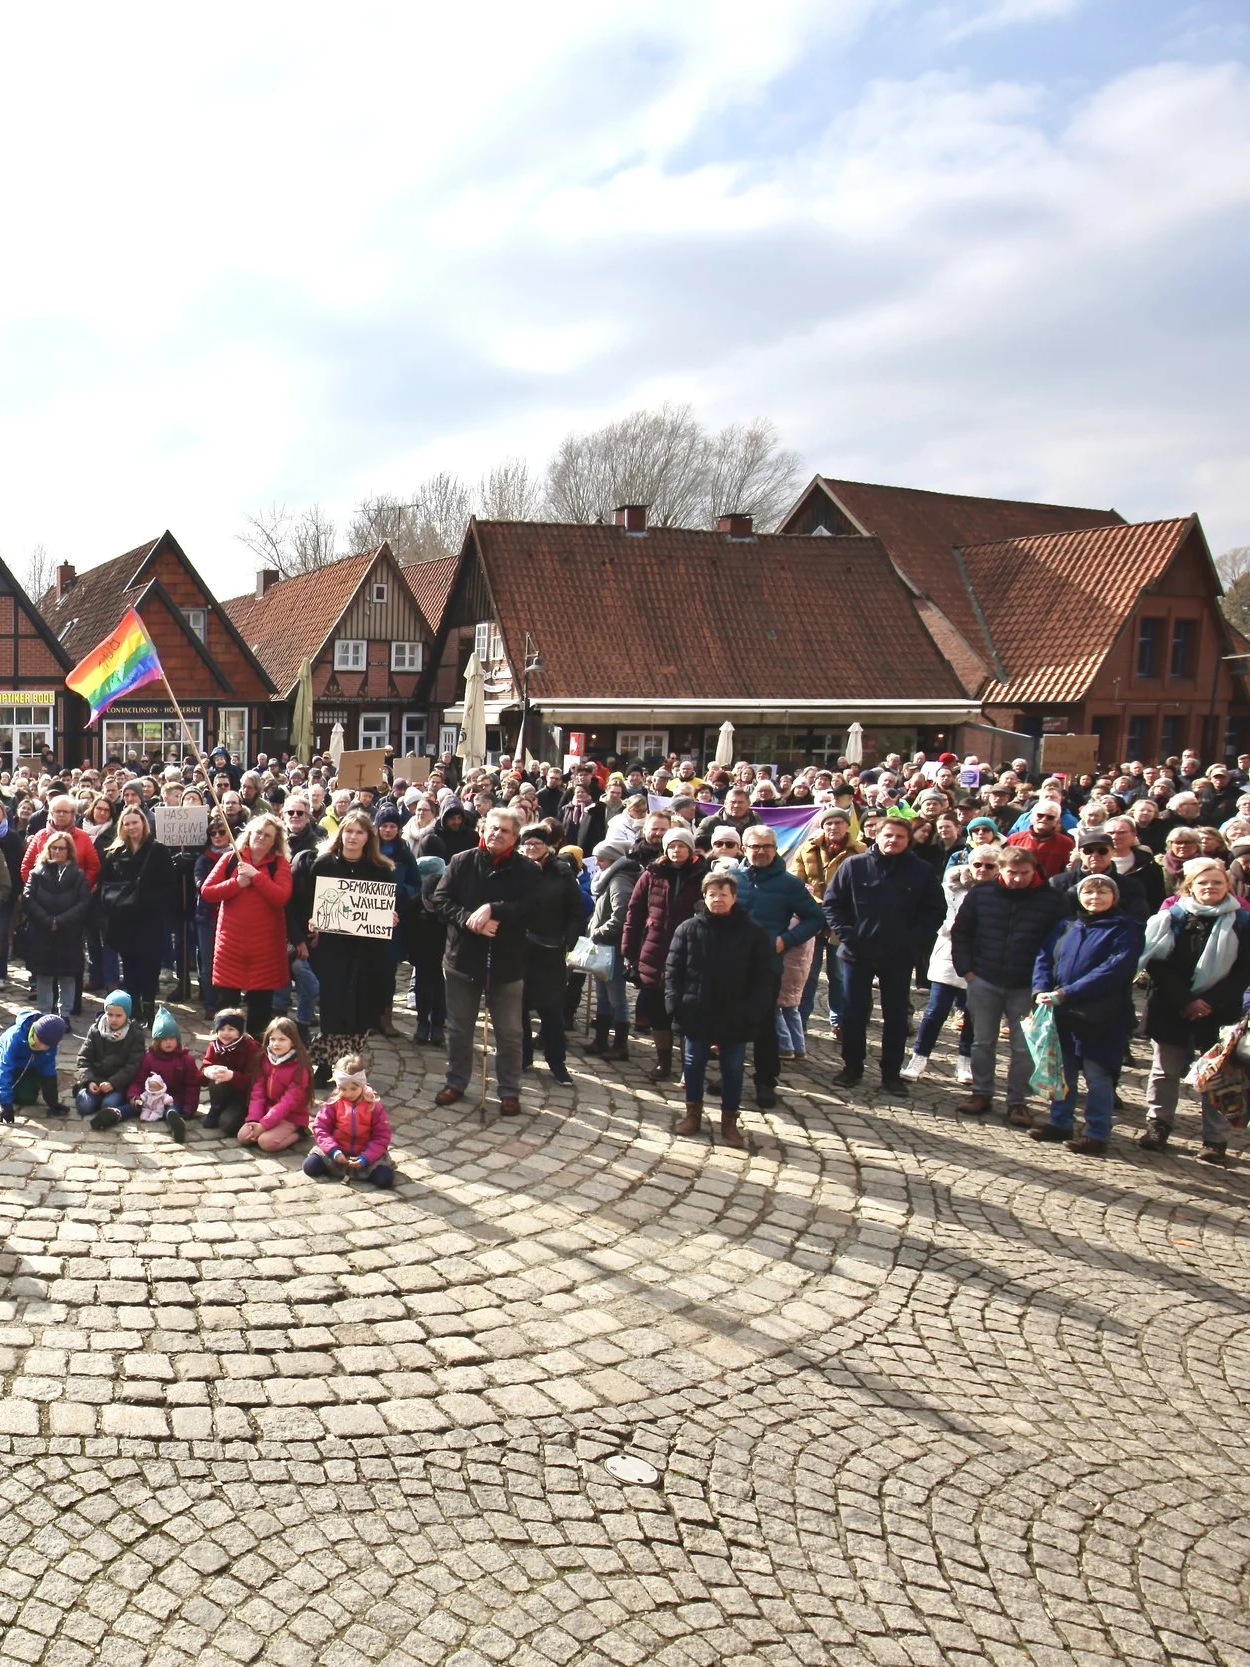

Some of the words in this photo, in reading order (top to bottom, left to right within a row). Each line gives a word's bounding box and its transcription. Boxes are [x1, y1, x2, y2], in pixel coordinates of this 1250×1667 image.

[33, 693, 54, 704] BODE
[106, 706, 158, 714] CONTACTLINSEN
[164, 809, 189, 820] HASS
[163, 823, 177, 833] IST
[178, 822, 205, 833] KEINE
[163, 834, 207, 845] MEINUNG
[350, 895, 395, 910] WÄHLEN
[352, 911, 368, 922] DU
[356, 923, 392, 937] MUSST
